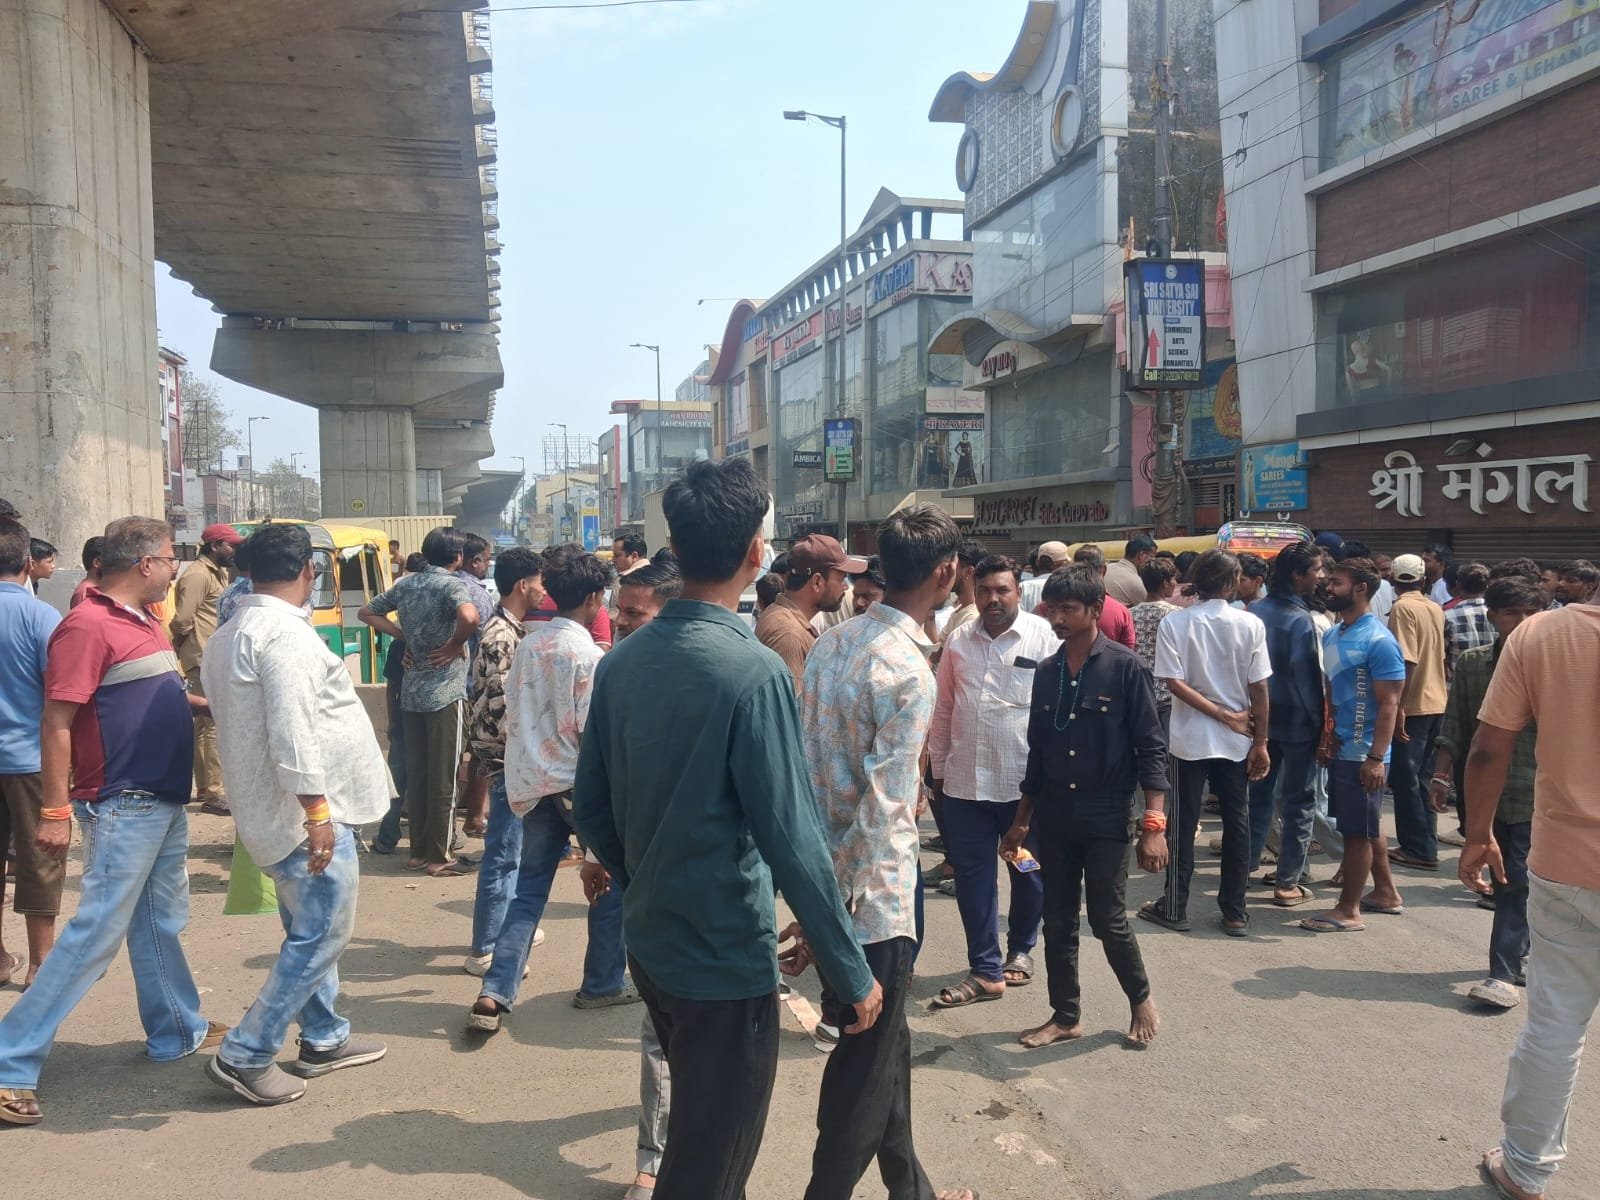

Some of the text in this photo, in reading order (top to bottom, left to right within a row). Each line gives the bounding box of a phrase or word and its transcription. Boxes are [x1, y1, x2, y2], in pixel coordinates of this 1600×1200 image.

[1451, 77, 1500, 110] SAREE
[1506, 72, 1517, 88] &
[1143, 281, 1199, 300] SRI SATYA SAI
[1147, 299, 1195, 316] UNIVERSITY
[794, 454, 822, 463] AMBICA
[1260, 471, 1285, 481] SAREES
[1368, 442, 1593, 517] श्री मंगल
[1354, 668, 1367, 744] BLUE RIDERS
